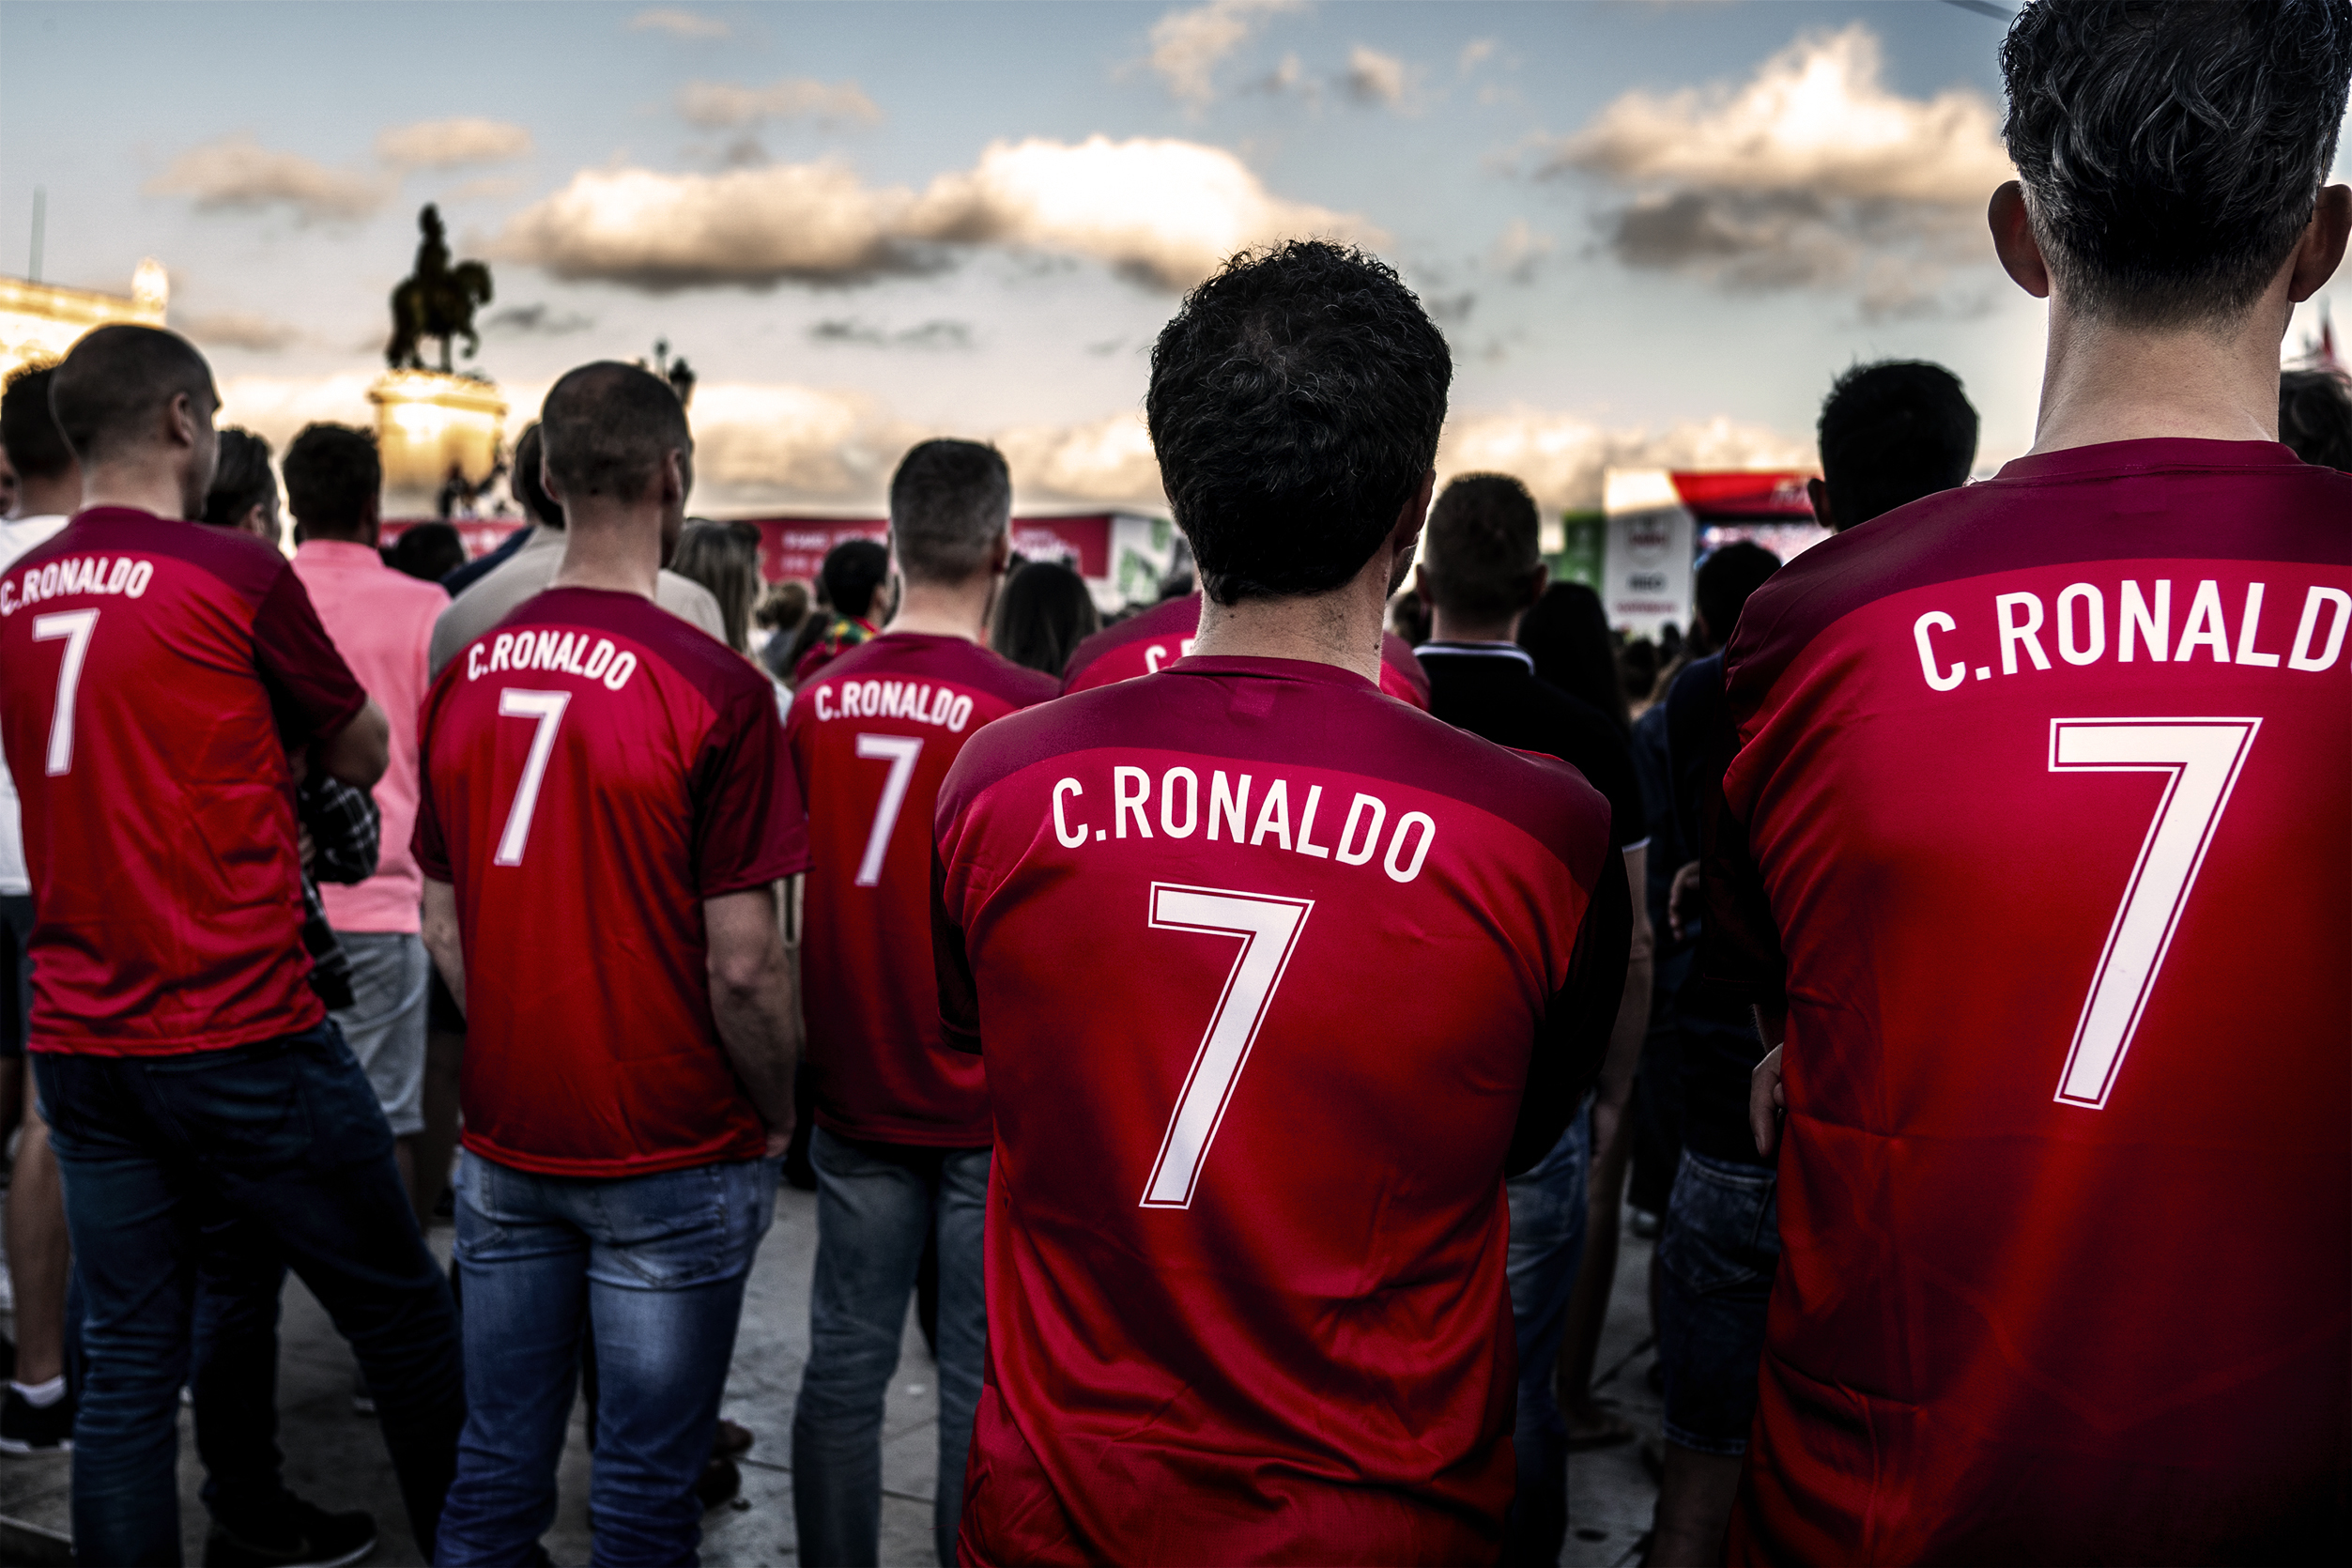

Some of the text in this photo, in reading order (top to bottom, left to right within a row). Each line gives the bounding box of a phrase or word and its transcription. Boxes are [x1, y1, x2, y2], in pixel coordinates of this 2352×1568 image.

[0, 556, 154, 617] C.RONALDO
[1913, 578, 2352, 692] C.RONALD
[31, 607, 101, 776] 7
[467, 629, 638, 691] C.RONALDO
[814, 680, 975, 733] C.RONALDO
[493, 686, 573, 867] 7
[854, 733, 923, 885] 7
[1052, 765, 1437, 884] C.RONALDO
[2047, 715, 2264, 1111] 7
[1138, 881, 1315, 1210] 7
